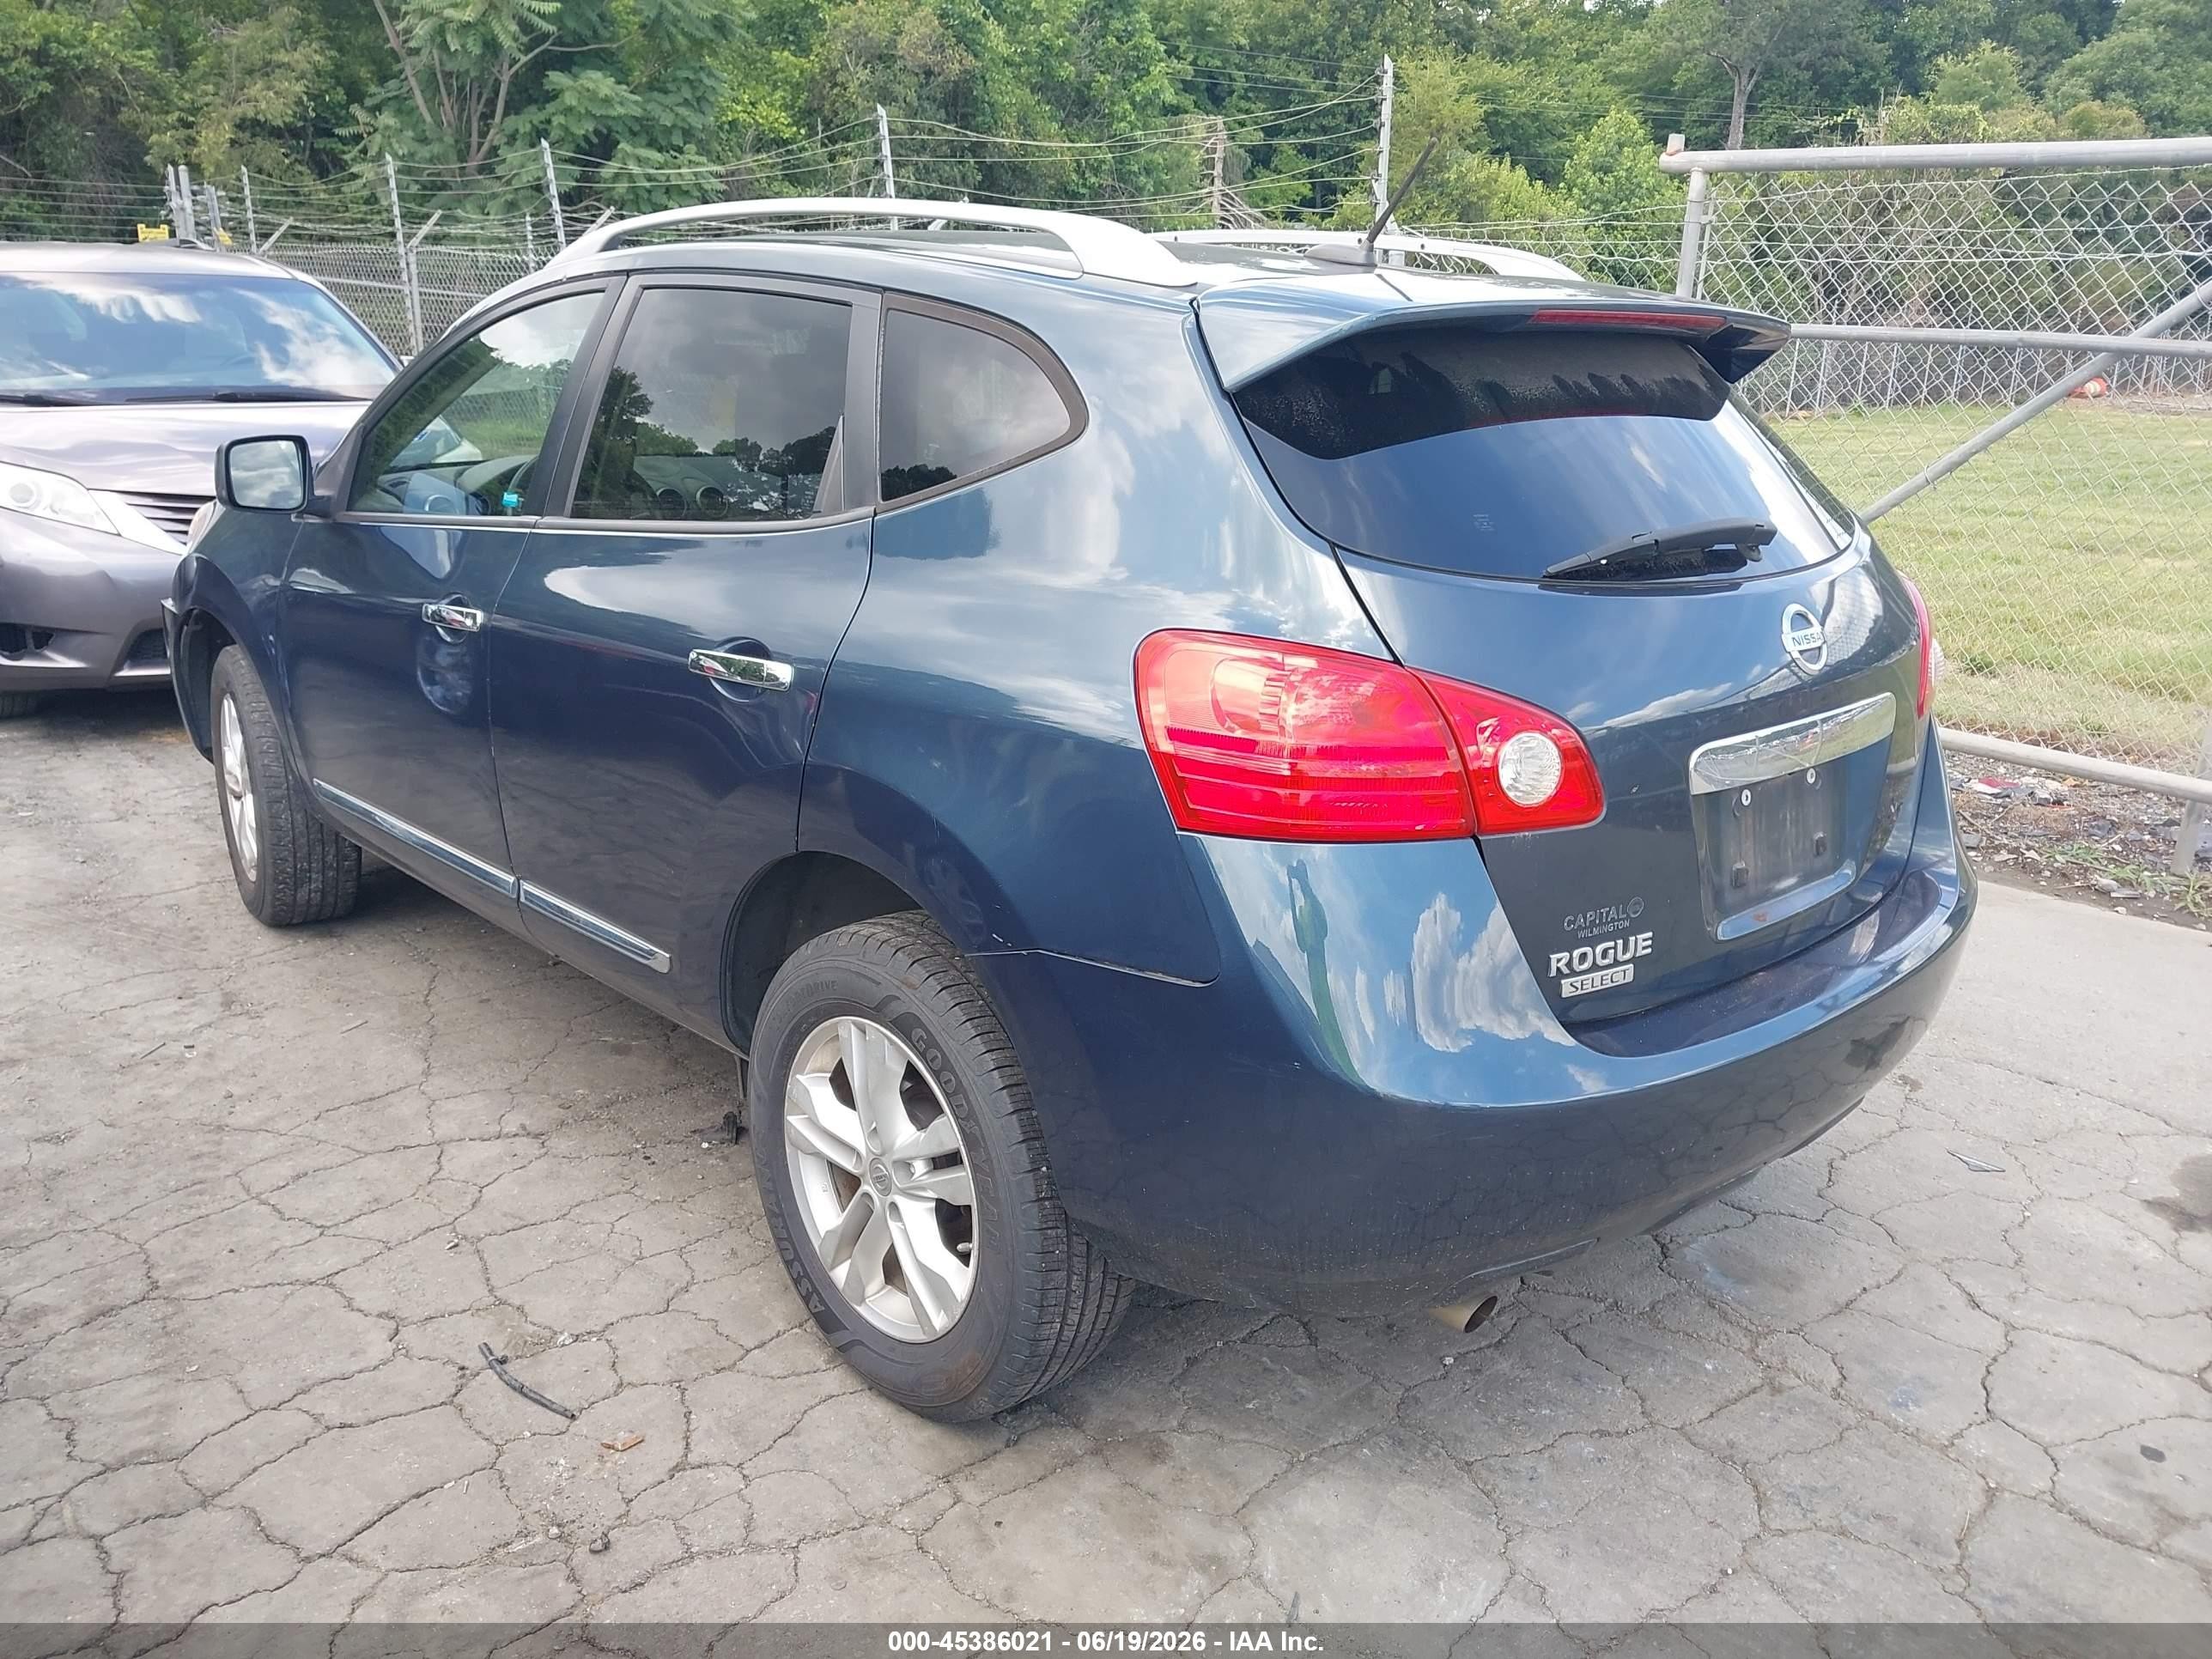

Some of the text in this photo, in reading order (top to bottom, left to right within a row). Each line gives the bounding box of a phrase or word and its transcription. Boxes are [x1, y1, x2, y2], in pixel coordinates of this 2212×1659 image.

[1790, 631, 1823, 647] NISSA
[1564, 904, 1627, 931] CAPITAL
[1577, 919, 1631, 939] WILMINGTON
[1548, 932, 1653, 977] ROGUE
[1569, 968, 1630, 994] SELECT
